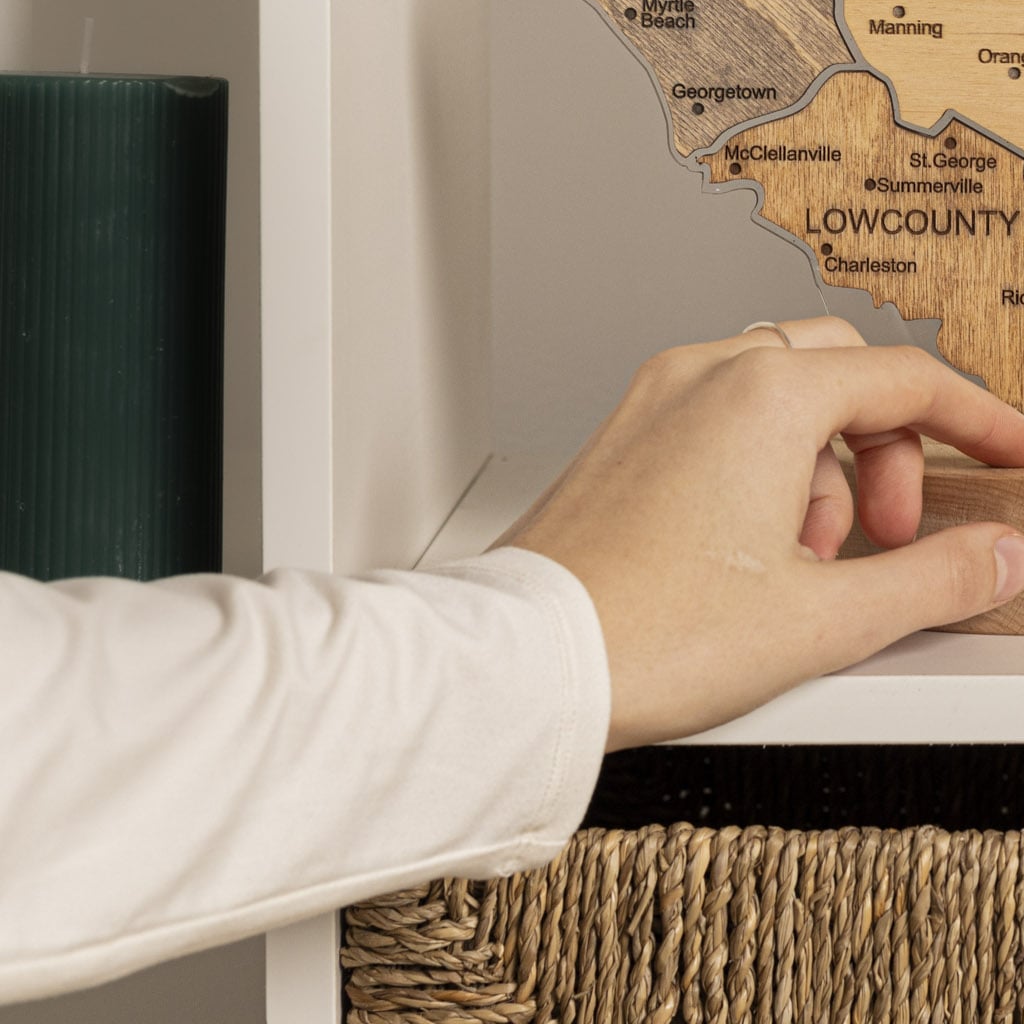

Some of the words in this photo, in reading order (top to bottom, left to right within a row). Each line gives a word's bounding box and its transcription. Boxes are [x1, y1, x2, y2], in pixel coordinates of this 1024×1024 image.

[641, 13, 695, 28] Beach
[868, 19, 943, 38] Manning
[672, 84, 777, 103] Georgetown
[724, 146, 842, 163] McClellanville
[909, 153, 997, 173] St.George
[877, 178, 983, 195] Summerville
[806, 209, 1020, 237] LOWCOUNTY
[824, 257, 917, 274] Charleston
